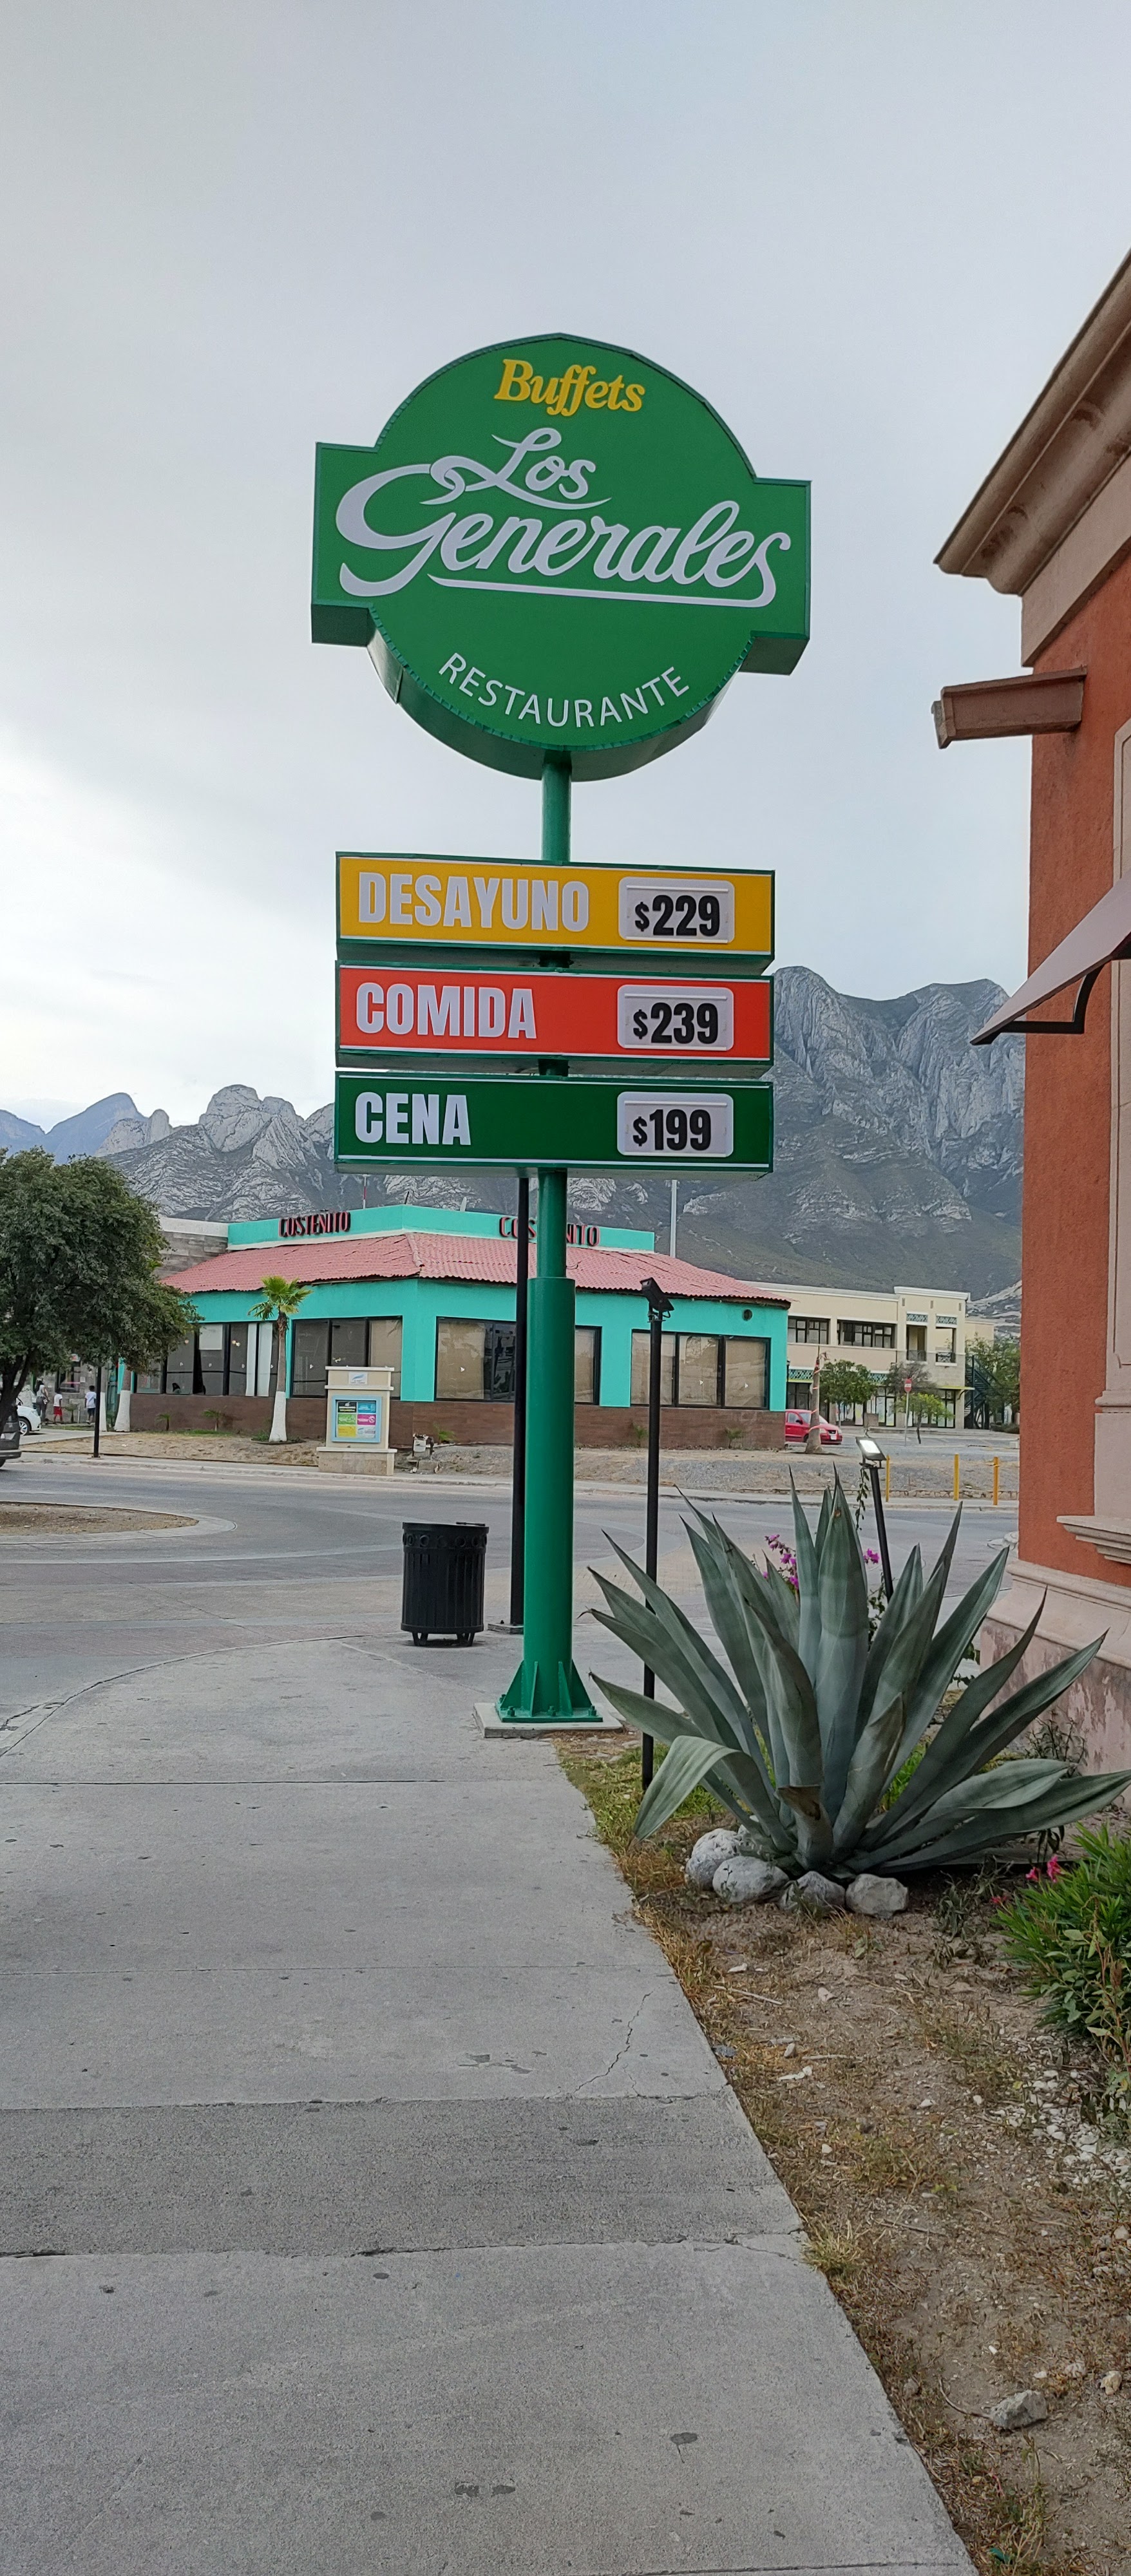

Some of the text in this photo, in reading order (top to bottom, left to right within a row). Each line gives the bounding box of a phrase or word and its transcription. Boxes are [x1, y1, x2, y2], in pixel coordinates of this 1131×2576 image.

[494, 358, 646, 417] Buffets
[428, 426, 611, 510] Los
[336, 463, 792, 608] Generales
[438, 652, 690, 728] RESTAURANTE
[358, 871, 721, 938] DESAYUNO $229
[356, 981, 719, 1045] COMIDA $239
[354, 1091, 712, 1152] CENA $199
